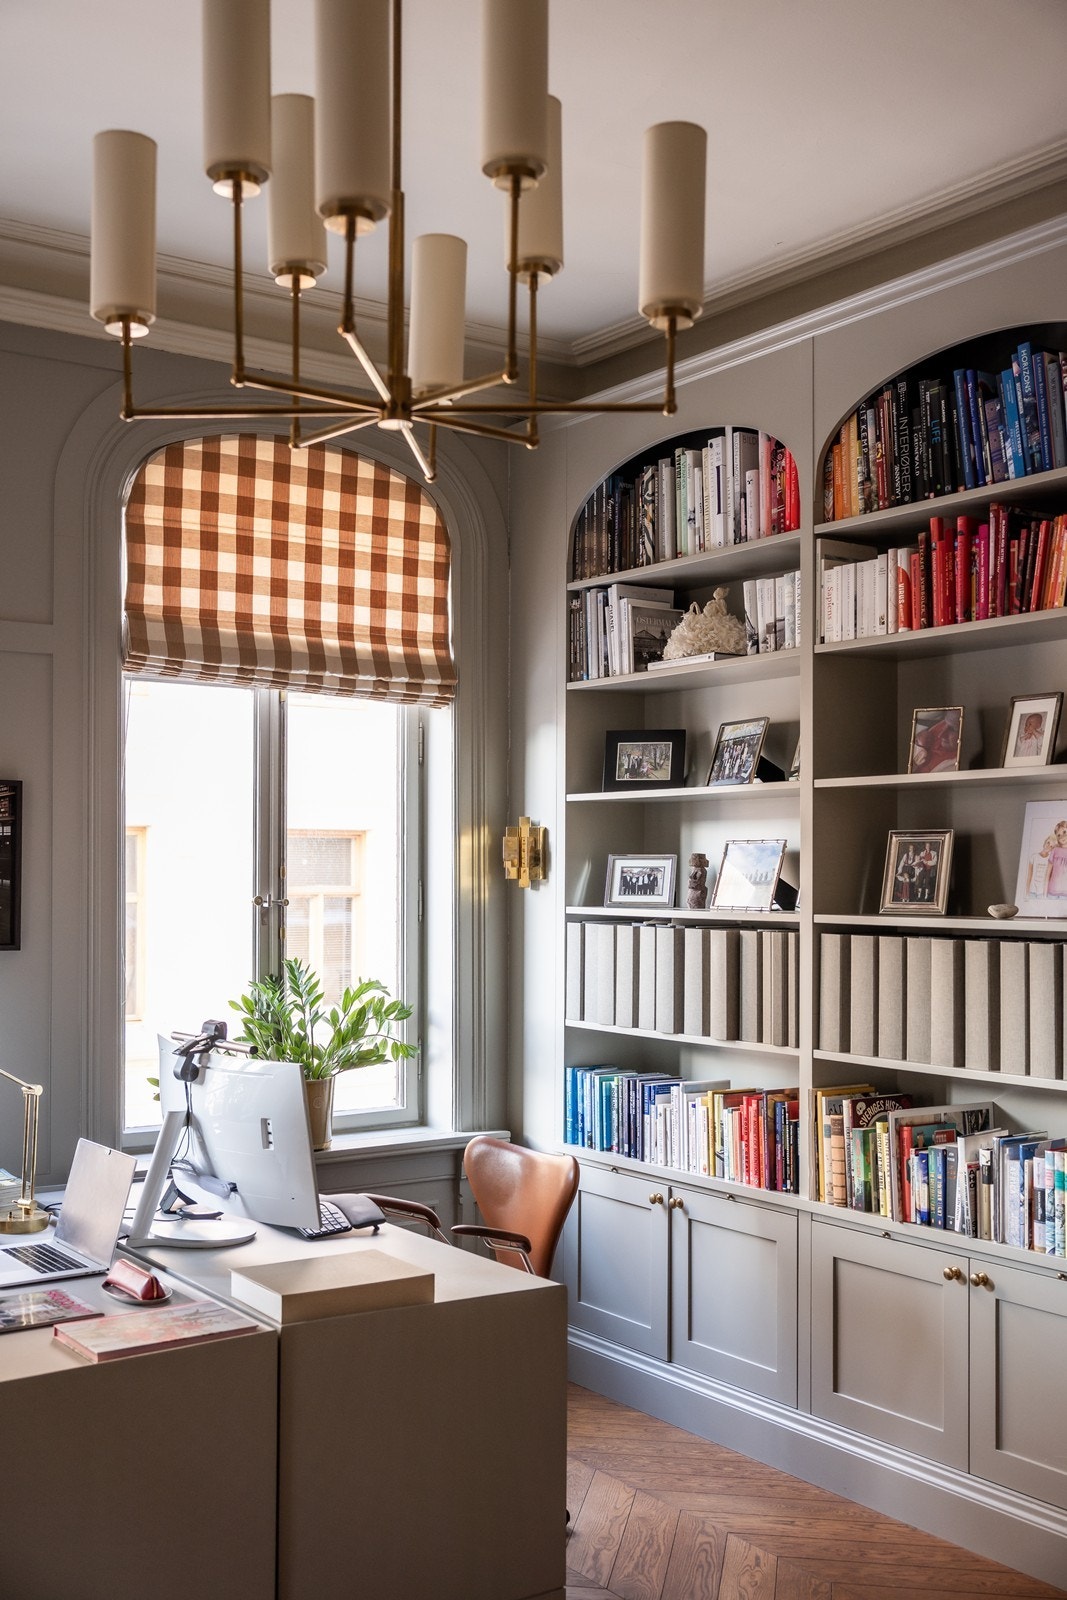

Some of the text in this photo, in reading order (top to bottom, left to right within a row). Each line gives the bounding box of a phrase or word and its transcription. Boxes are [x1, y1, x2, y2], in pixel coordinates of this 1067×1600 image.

[1020, 349, 1031, 393] HORIZONS
[930, 419, 941, 444] LIFE
[898, 416, 912, 492] INTERIØRER
[826, 586, 834, 620] Sapiens
[860, 1100, 885, 1127] SVERIGES
